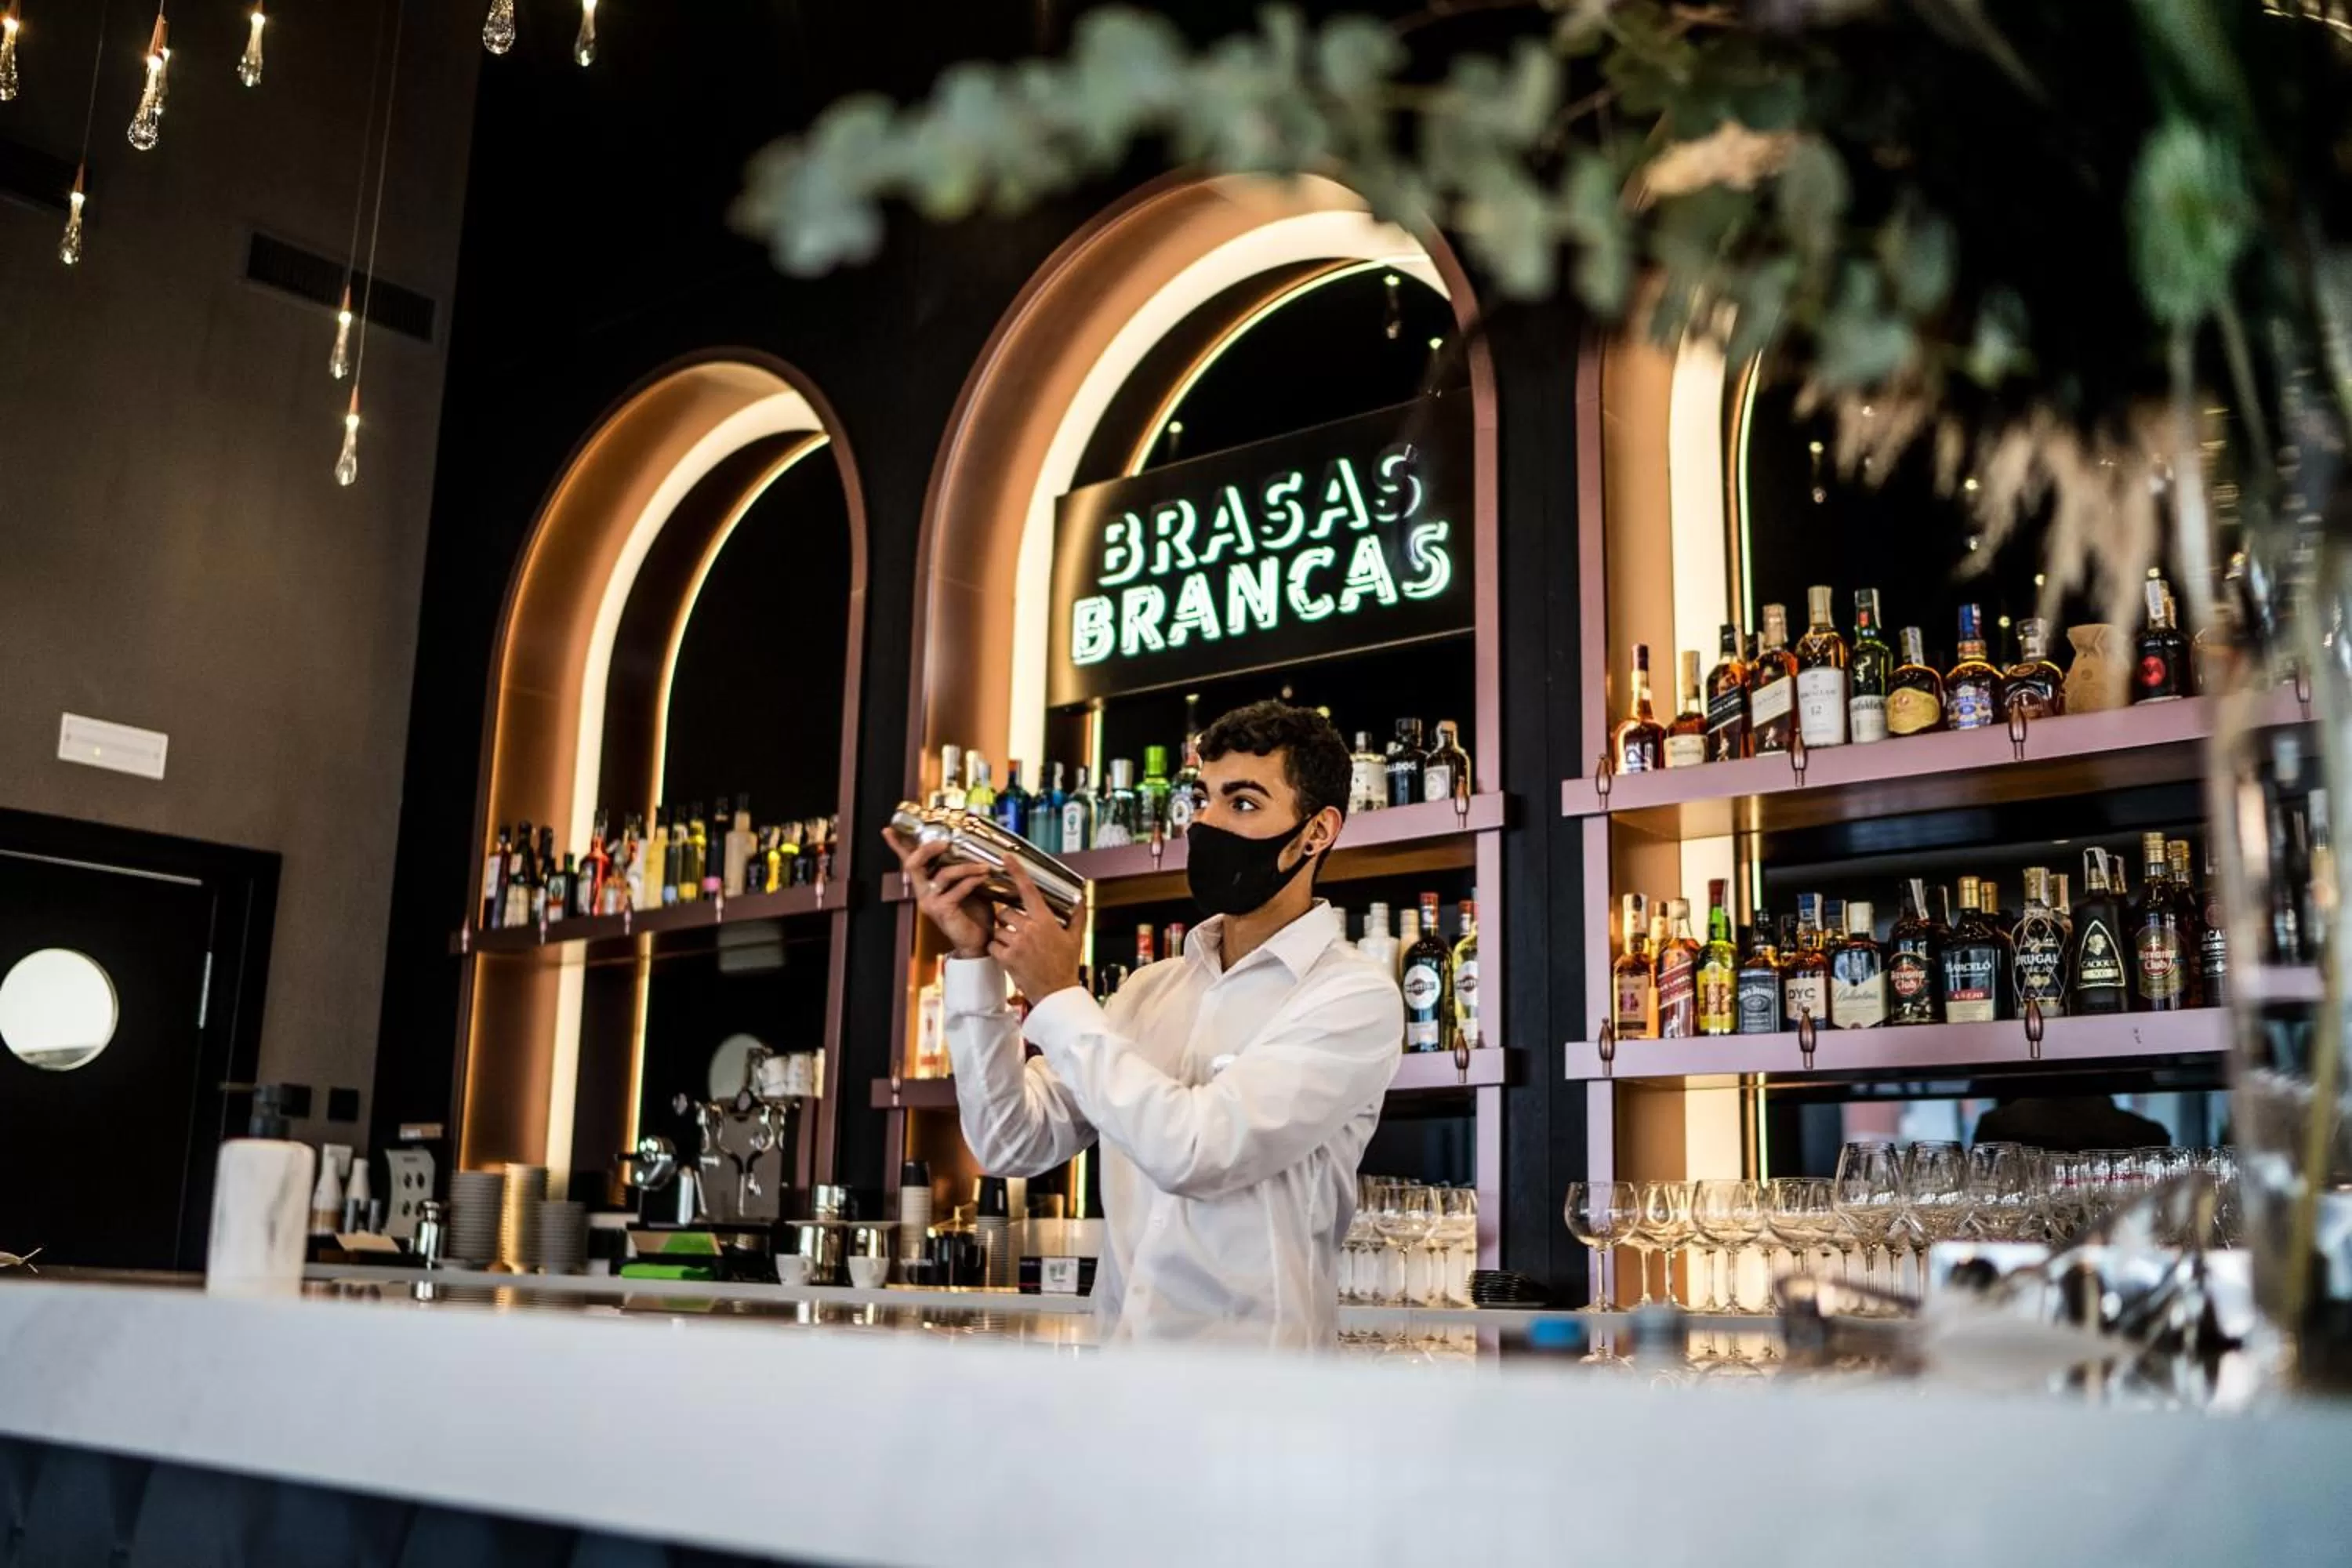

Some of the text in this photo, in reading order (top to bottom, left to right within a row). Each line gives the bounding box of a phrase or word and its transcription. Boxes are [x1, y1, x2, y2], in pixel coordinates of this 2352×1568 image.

[1098, 444, 1421, 586] BRASAS
[1071, 521, 1452, 666] BRANCAS
[1788, 987, 1817, 1000] DYC
